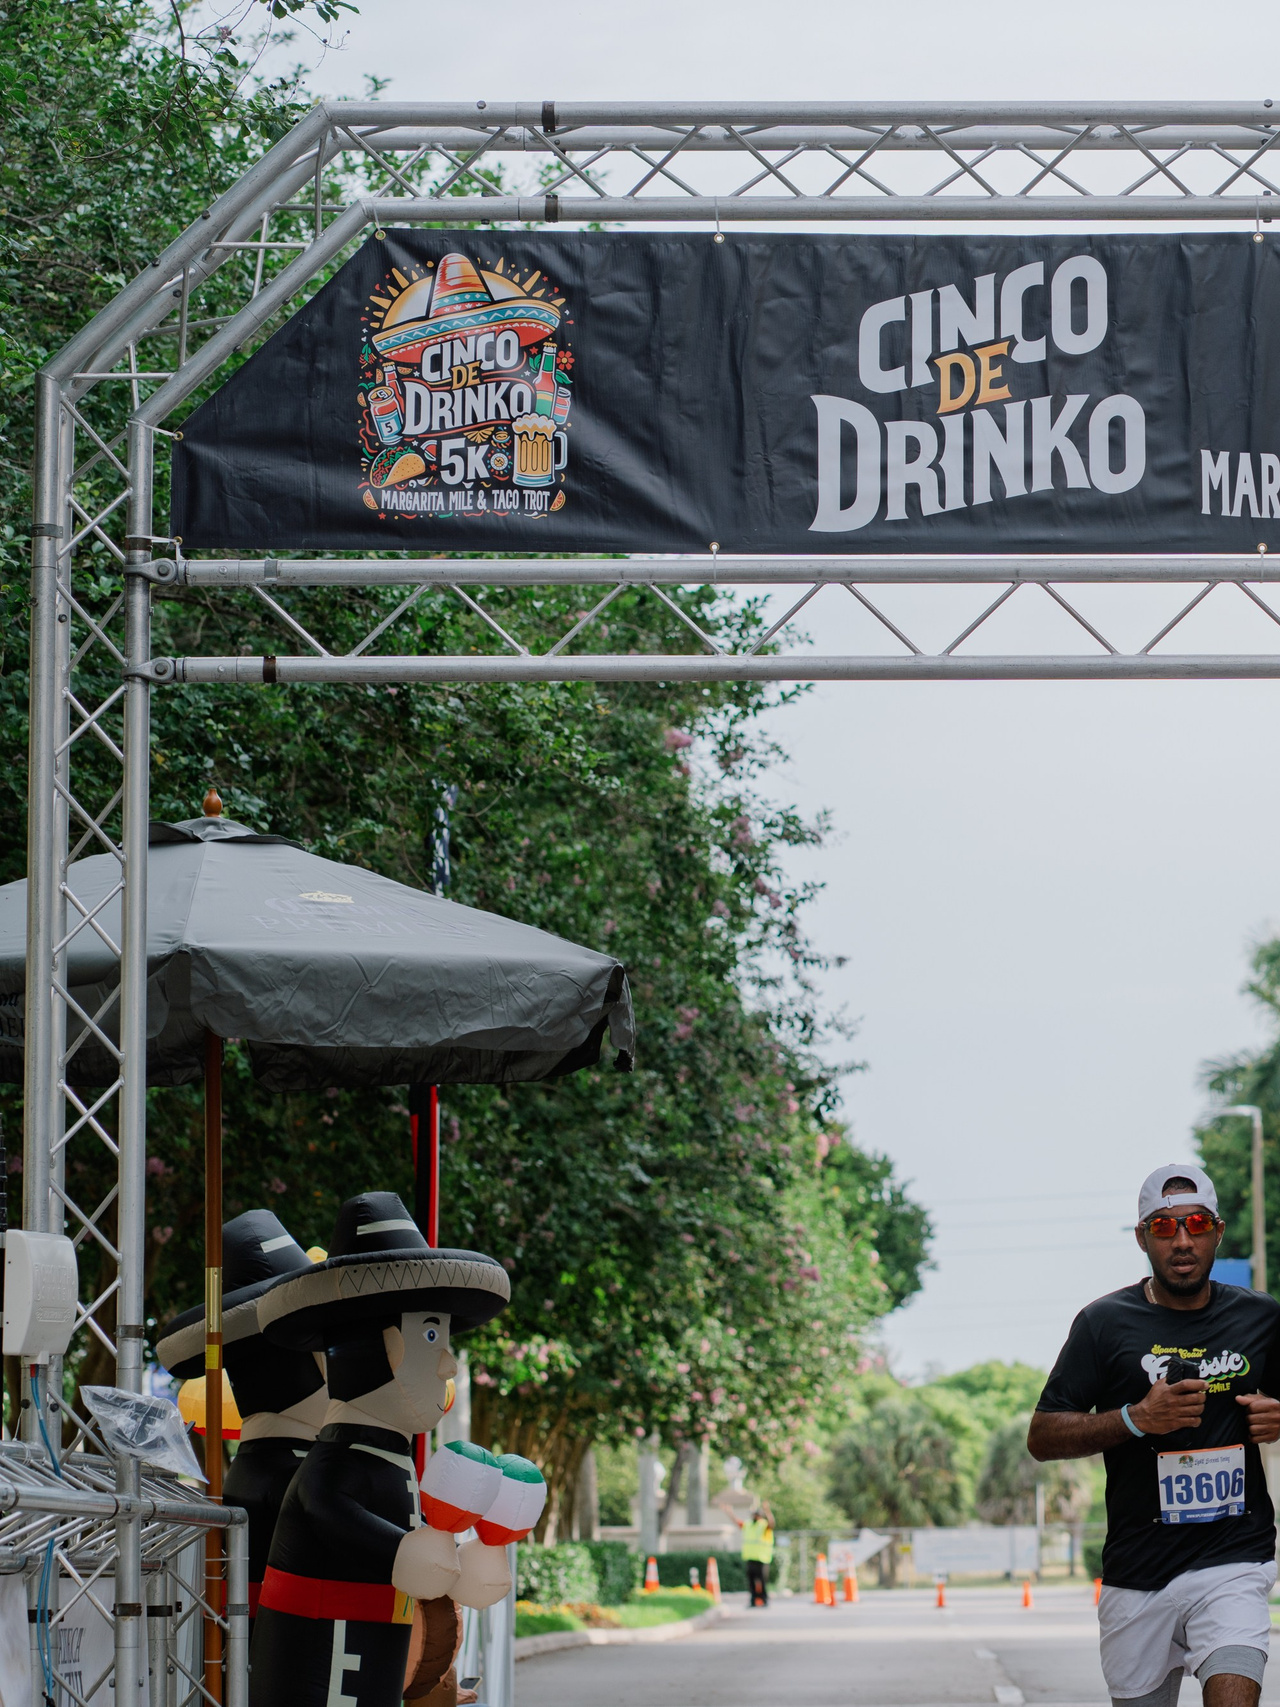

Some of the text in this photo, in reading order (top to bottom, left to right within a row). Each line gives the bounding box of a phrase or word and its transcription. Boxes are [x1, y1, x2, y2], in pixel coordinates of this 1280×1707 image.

[859, 255, 1108, 394] CINCO
[422, 330, 520, 382] CINCO
[451, 361, 481, 390] DE
[934, 340, 1013, 414] DE
[385, 422, 393, 433] 5
[402, 380, 536, 435] DRINKO
[440, 439, 490, 485] 5K
[807, 393, 1146, 533] DRINKO
[380, 489, 551, 511] MARGARITA MILE & TACO TROT
[1140, 1349, 1245, 1387] Cssic
[1151, 1344, 1207, 1359] Space Coast
[1160, 1468, 1244, 1505] 13606
